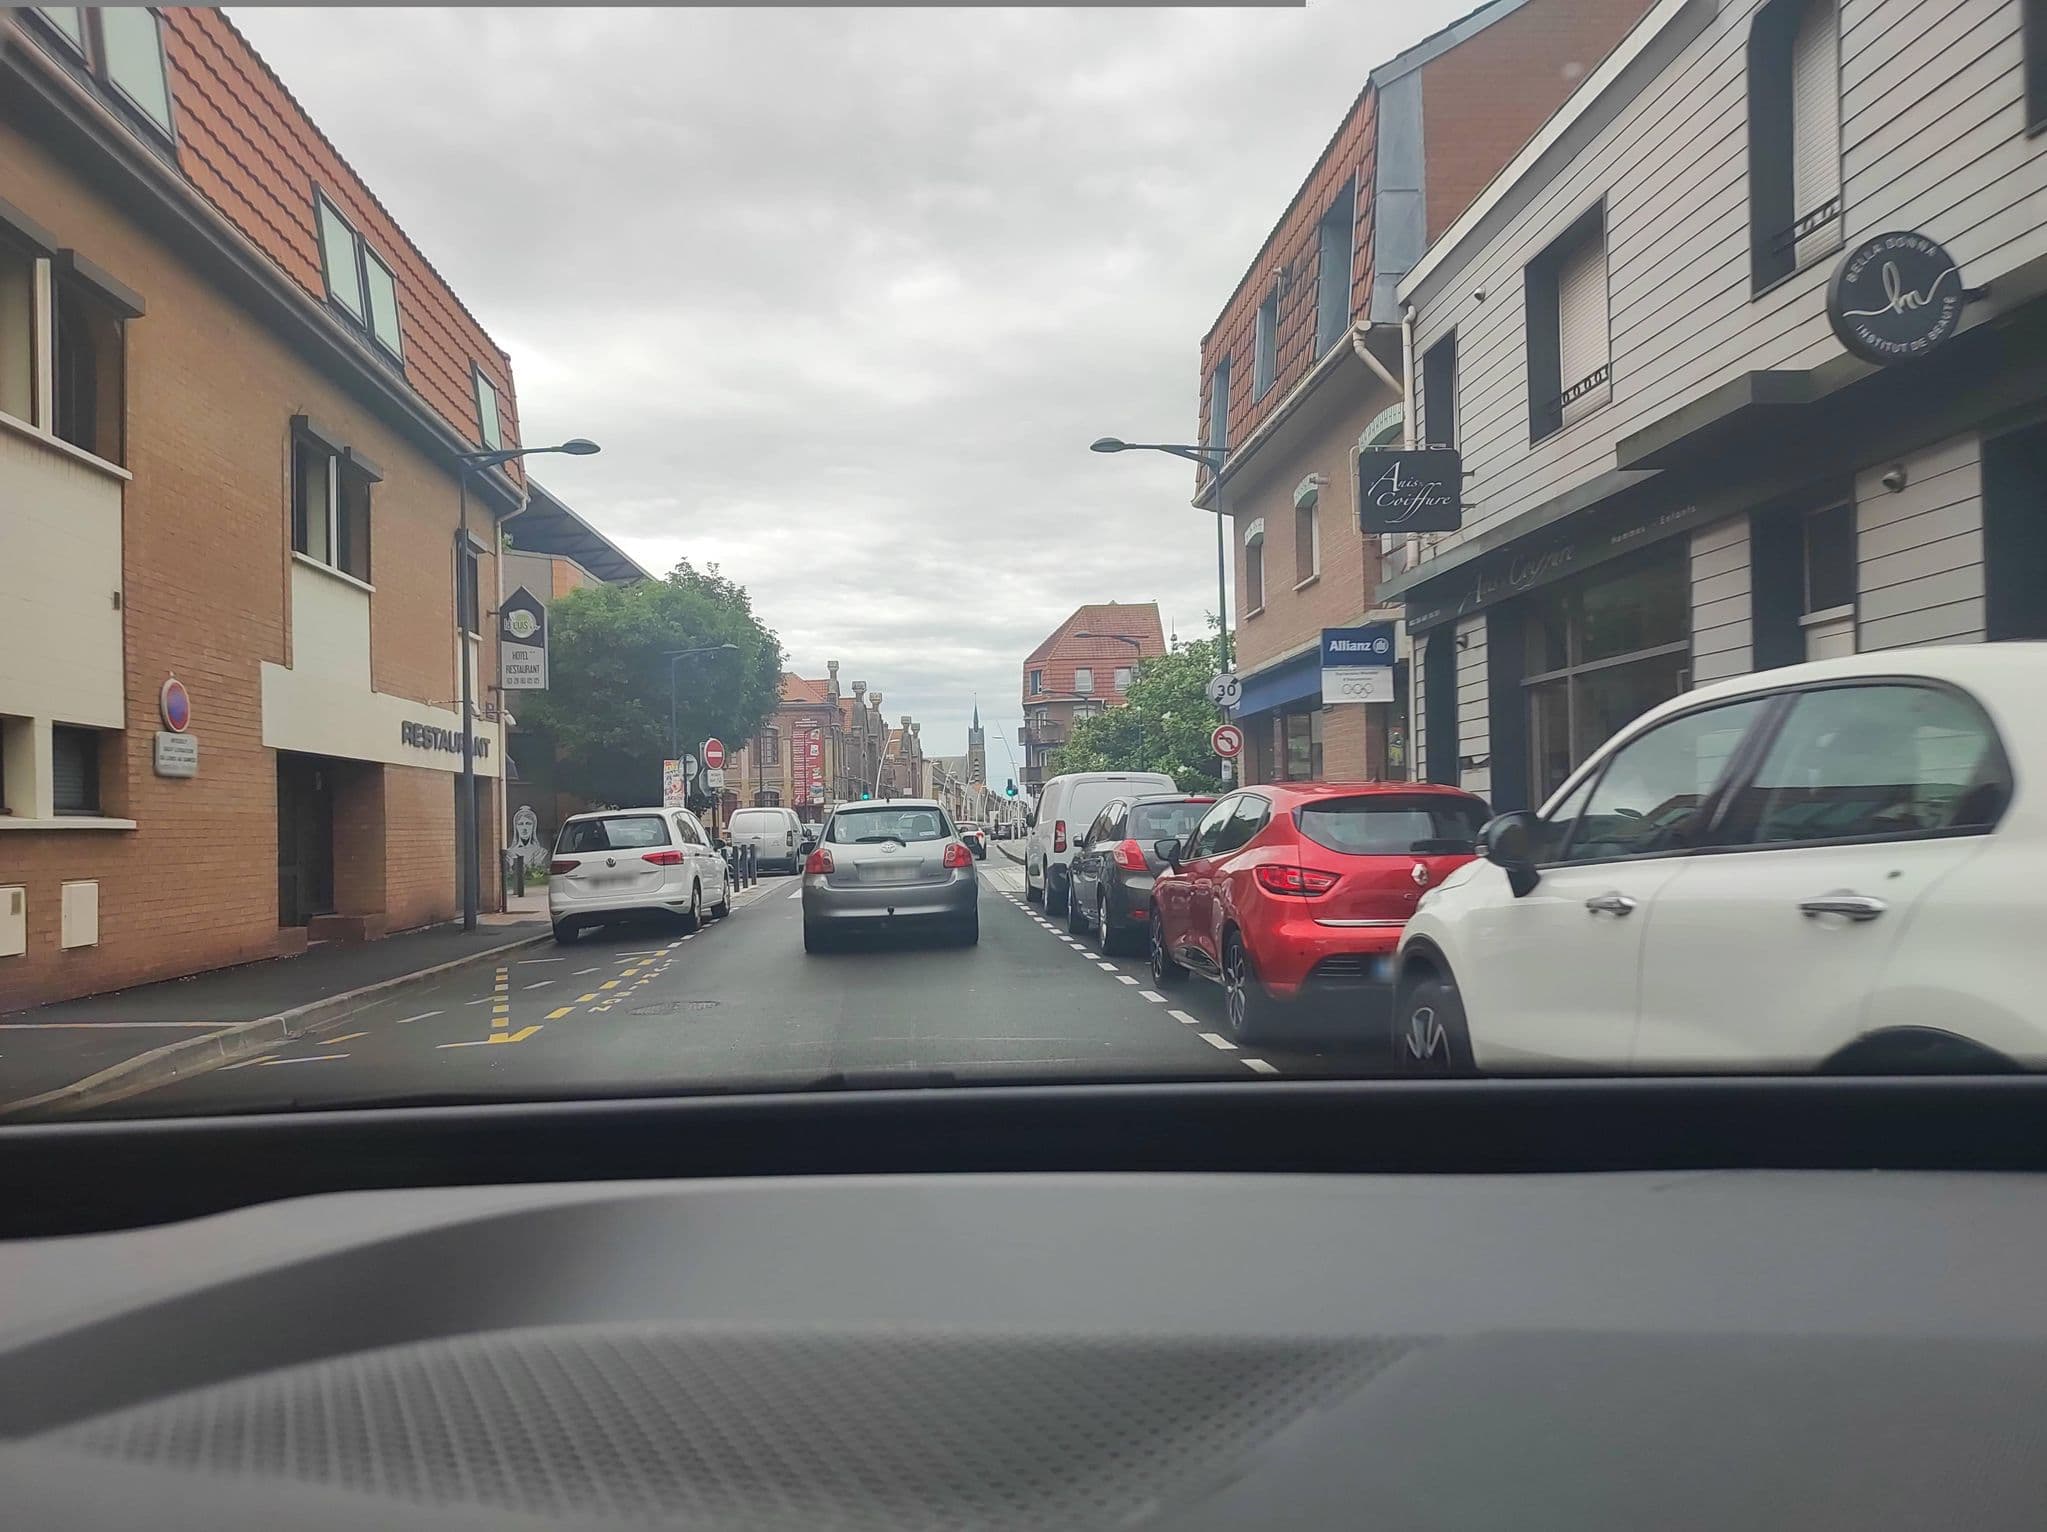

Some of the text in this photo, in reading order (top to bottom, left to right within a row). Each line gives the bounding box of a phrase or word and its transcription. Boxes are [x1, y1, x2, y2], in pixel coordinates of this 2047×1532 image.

[1846, 236, 1937, 283] BELLA DONNA
[1856, 323, 1908, 353] INSTITUT
[1910, 337, 1928, 351] DE
[1367, 461, 1418, 497] Anis
[1376, 482, 1452, 524] Coiffure
[512, 651, 528, 661] HOTEL
[1329, 640, 1371, 652] Allianz
[505, 664, 540, 675] RESTAURANT
[1217, 684, 1237, 697] 30
[401, 719, 491, 759] RESTAURNT
